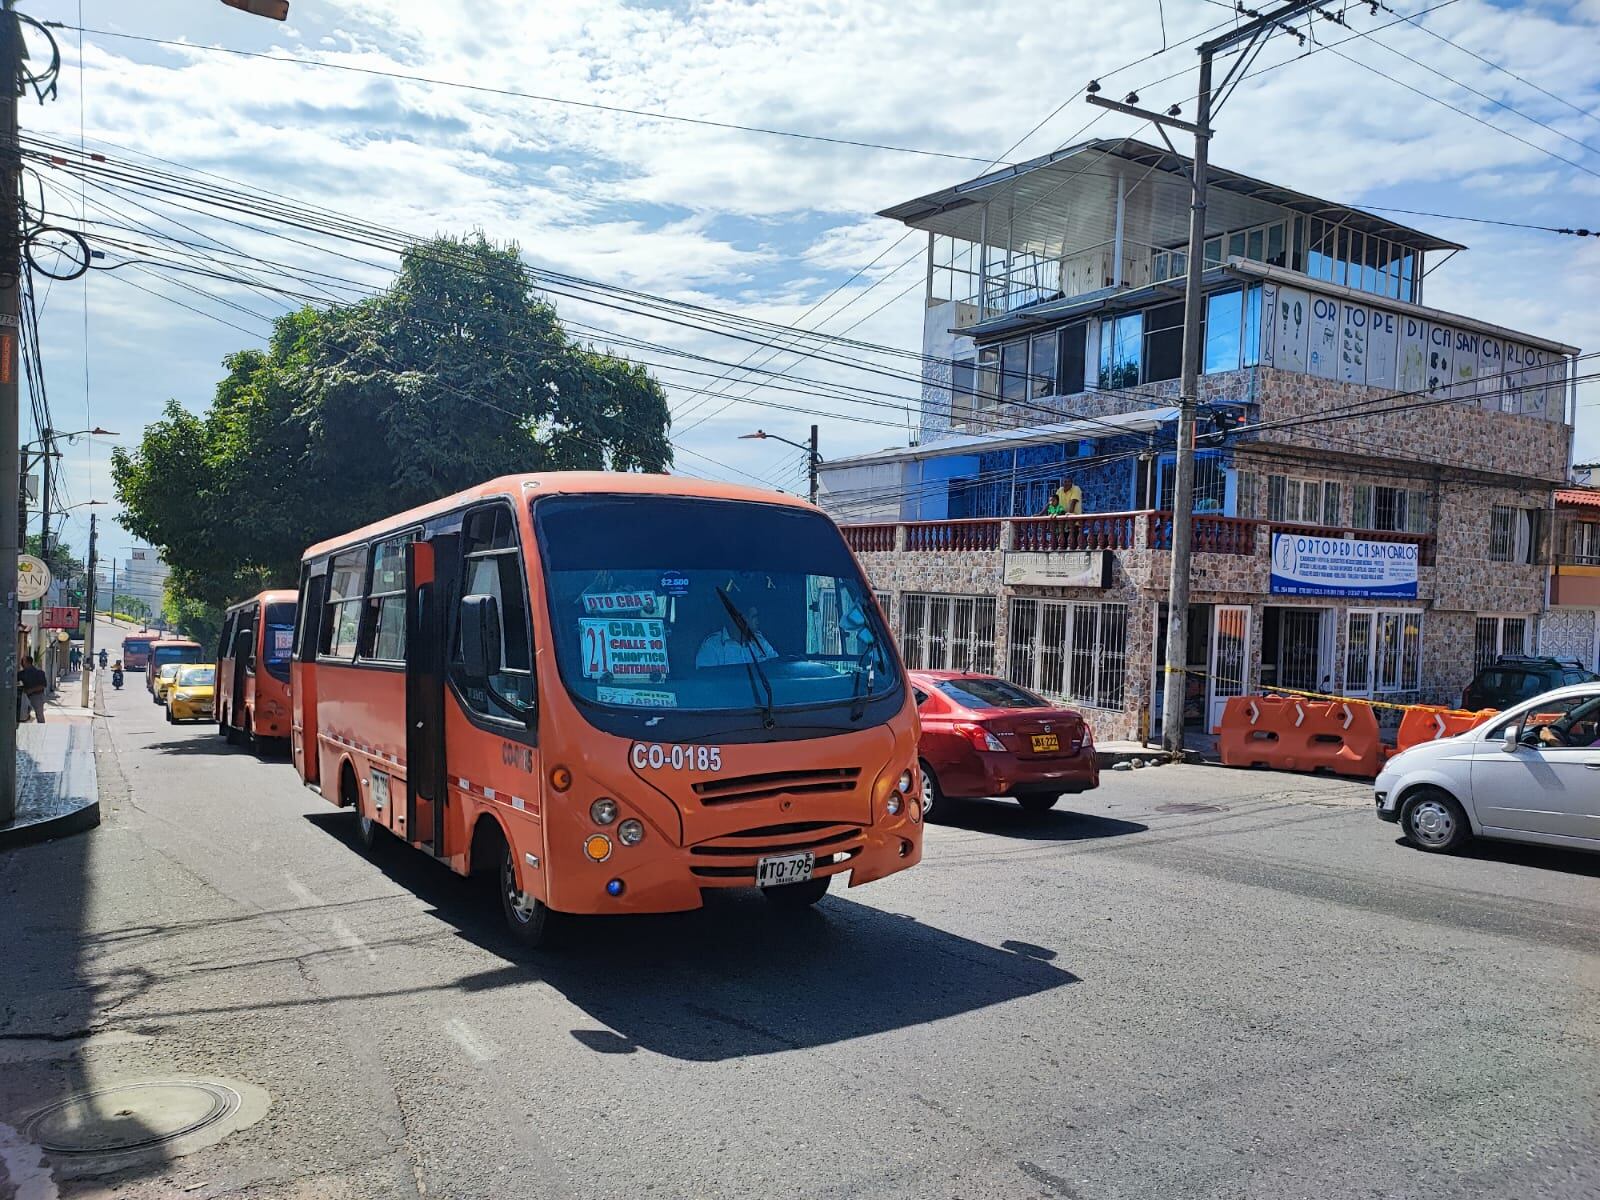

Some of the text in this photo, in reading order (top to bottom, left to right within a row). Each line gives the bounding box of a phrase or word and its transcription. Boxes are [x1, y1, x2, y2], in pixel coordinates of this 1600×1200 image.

[1456, 332, 1479, 355] SAN
[1482, 338, 1543, 367] CARLOS
[1297, 539, 1418, 560] ORTOPEDICA SAN CARLOS
[616, 595, 642, 607] CRA
[643, 594, 655, 605] 5
[609, 622, 661, 637] CRA 5
[587, 627, 608, 672] 21
[610, 639, 647, 649] CALLE
[611, 652, 665, 662] PANOPTICO
[632, 743, 722, 771] CO-0185
